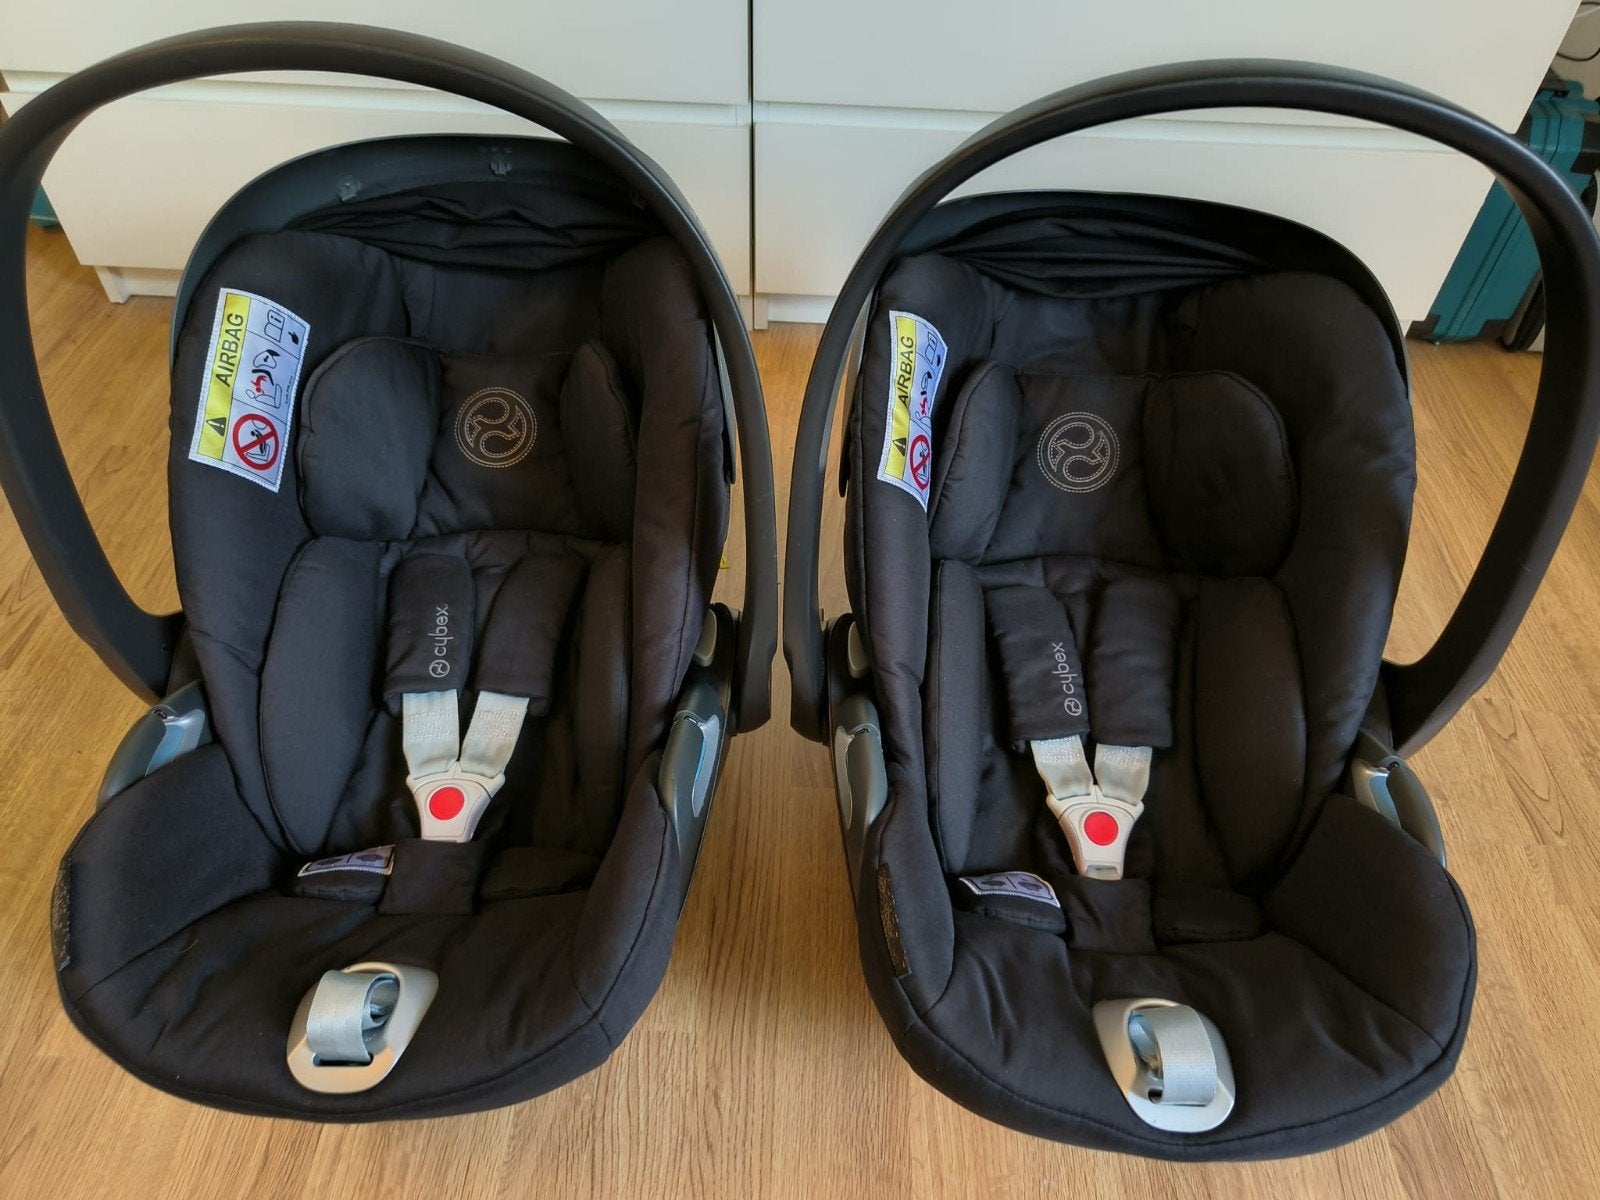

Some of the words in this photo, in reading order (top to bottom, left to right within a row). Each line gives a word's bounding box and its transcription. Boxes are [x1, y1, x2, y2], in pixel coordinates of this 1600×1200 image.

[215, 313, 244, 387] AIRBAG
[897, 335, 914, 407] AIRBAG
[428, 604, 454, 656] cybex
[1052, 642, 1078, 694] cybex
